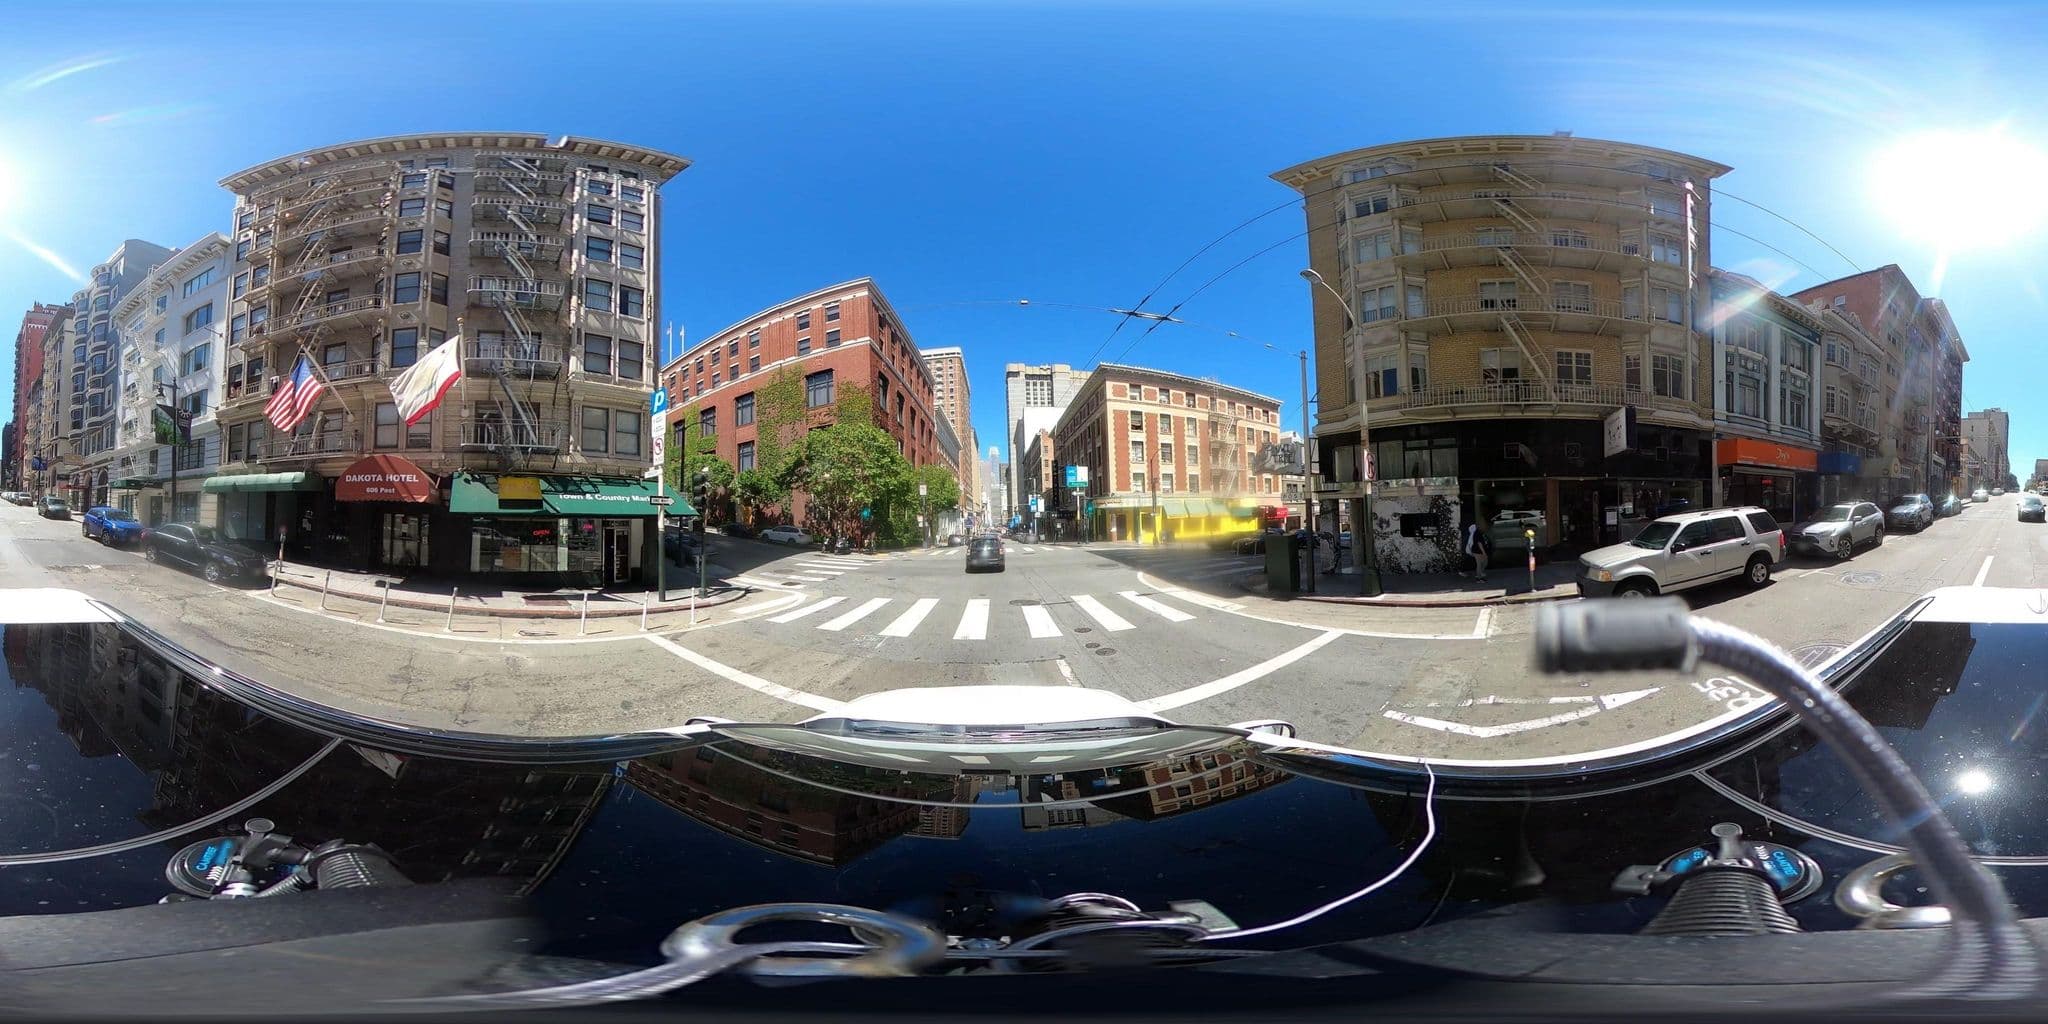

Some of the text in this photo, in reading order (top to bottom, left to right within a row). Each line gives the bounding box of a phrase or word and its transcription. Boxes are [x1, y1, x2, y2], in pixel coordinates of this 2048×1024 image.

[345, 473, 419, 482] DAKOTA HOTEL
[559, 493, 584, 501] Town
[585, 493, 594, 501] &
[596, 493, 630, 503] Country
